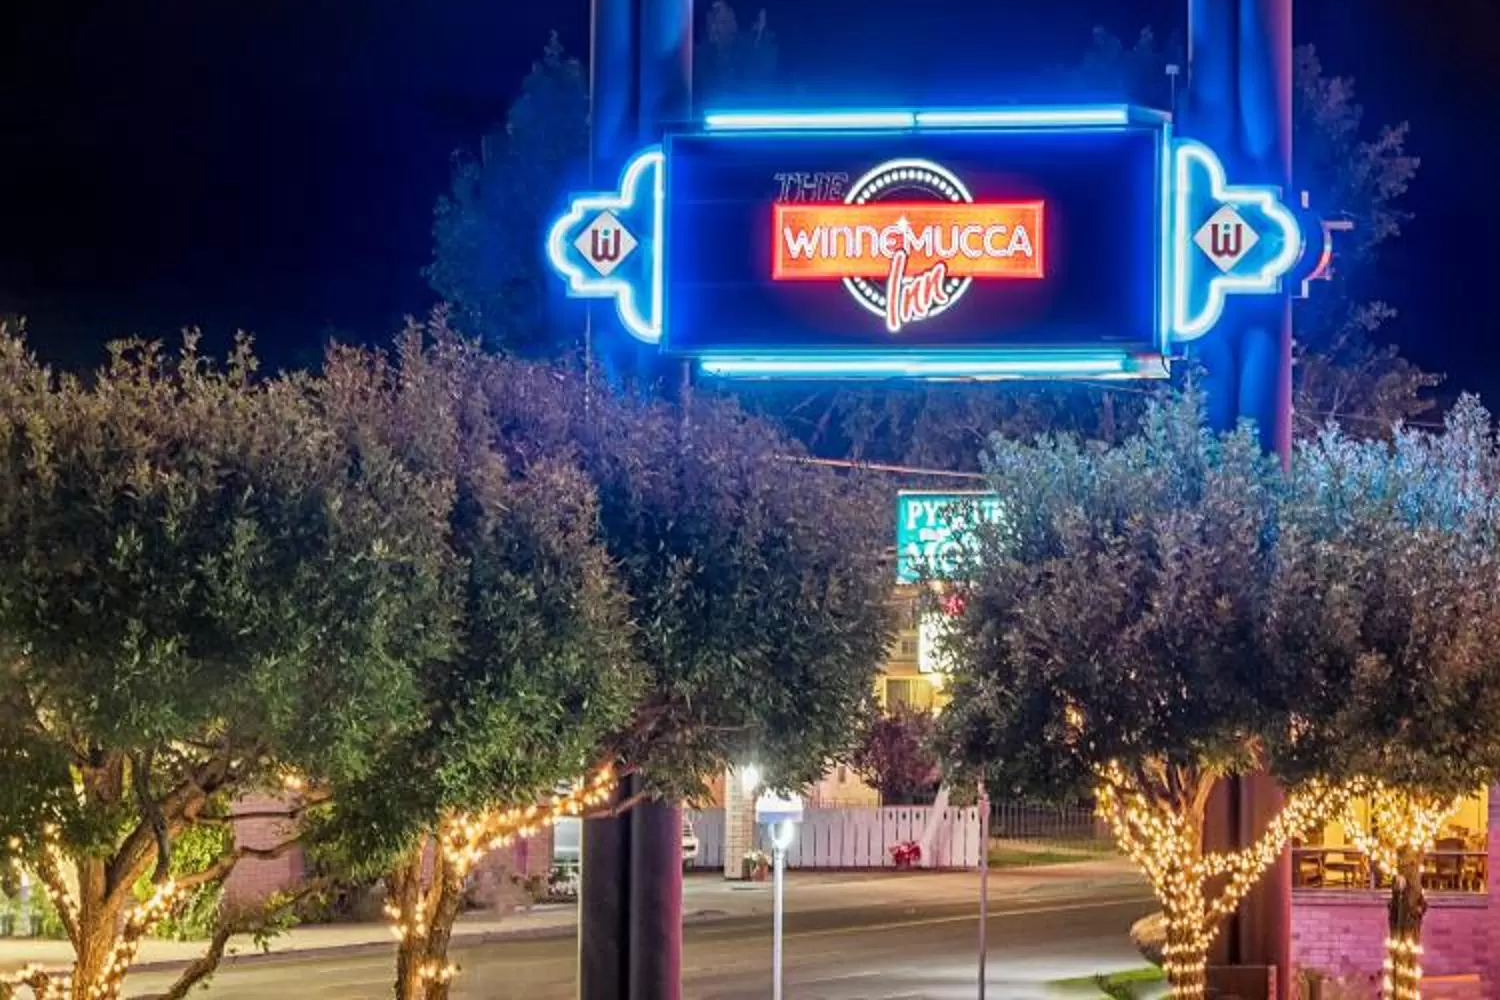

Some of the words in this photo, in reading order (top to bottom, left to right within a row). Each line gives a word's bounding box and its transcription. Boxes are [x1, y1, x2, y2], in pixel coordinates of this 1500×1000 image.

[773, 171, 849, 203] THE
[783, 223, 1034, 259] WINNEMUCCA
[886, 248, 949, 334] Inn
